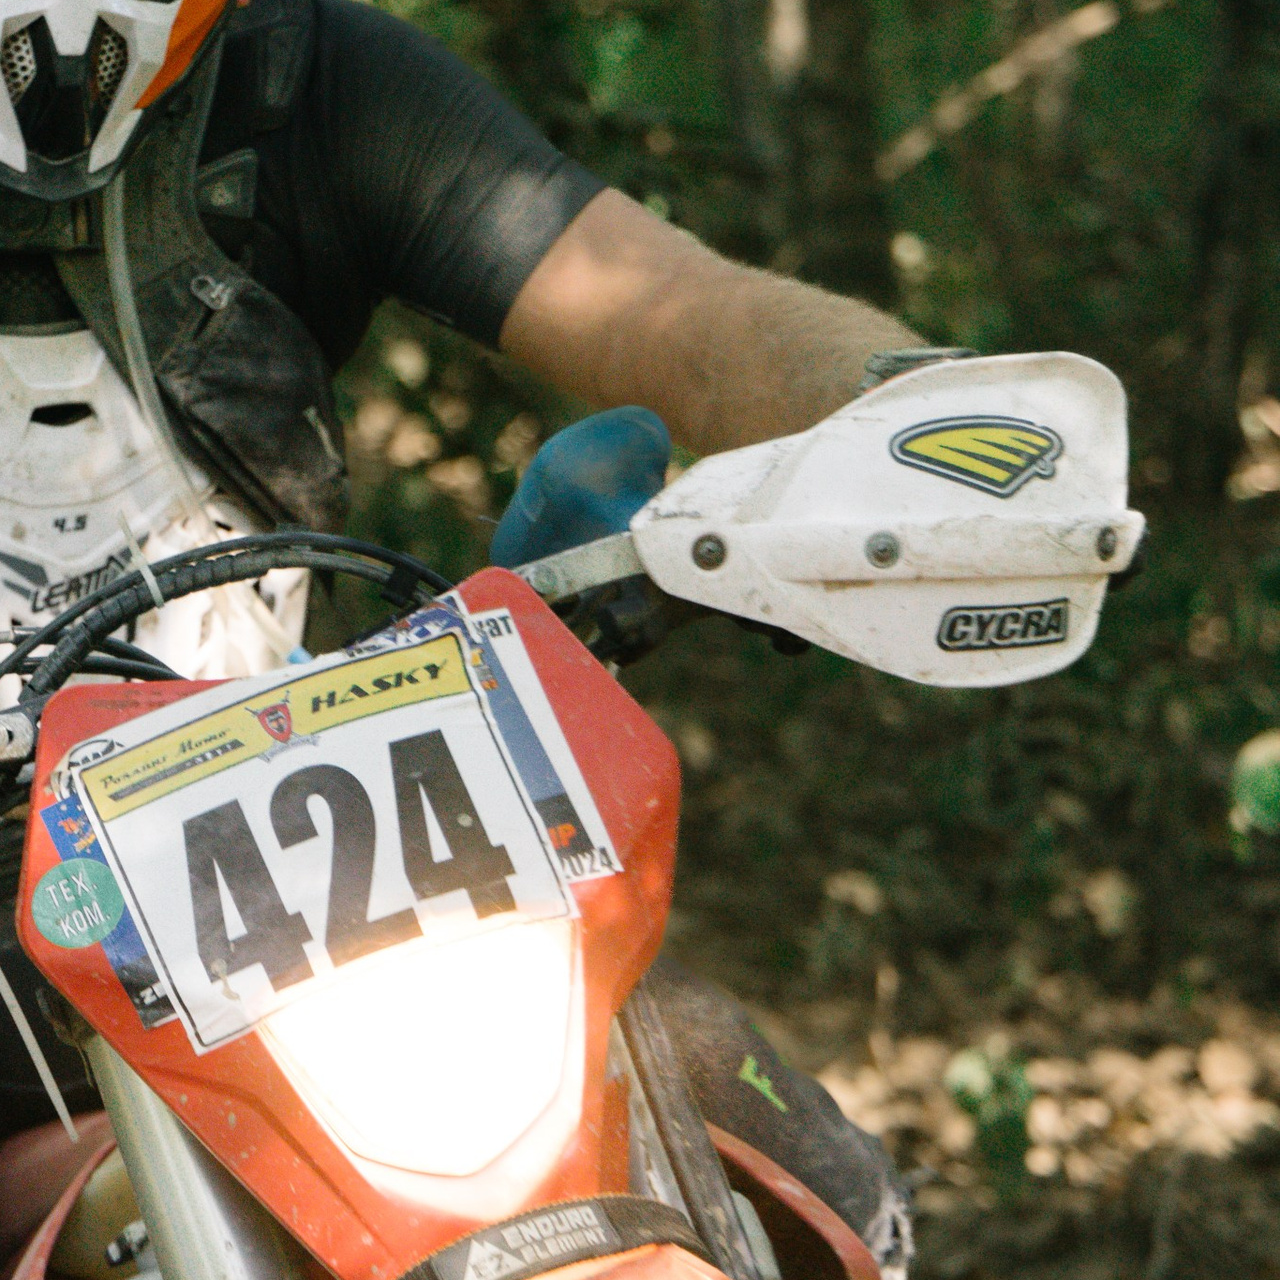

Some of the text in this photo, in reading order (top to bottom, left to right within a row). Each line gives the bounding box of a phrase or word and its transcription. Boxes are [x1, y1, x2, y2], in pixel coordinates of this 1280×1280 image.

[945, 606, 1064, 643] CYCRA
[311, 658, 447, 713] HASKY
[182, 728, 518, 993] 424
